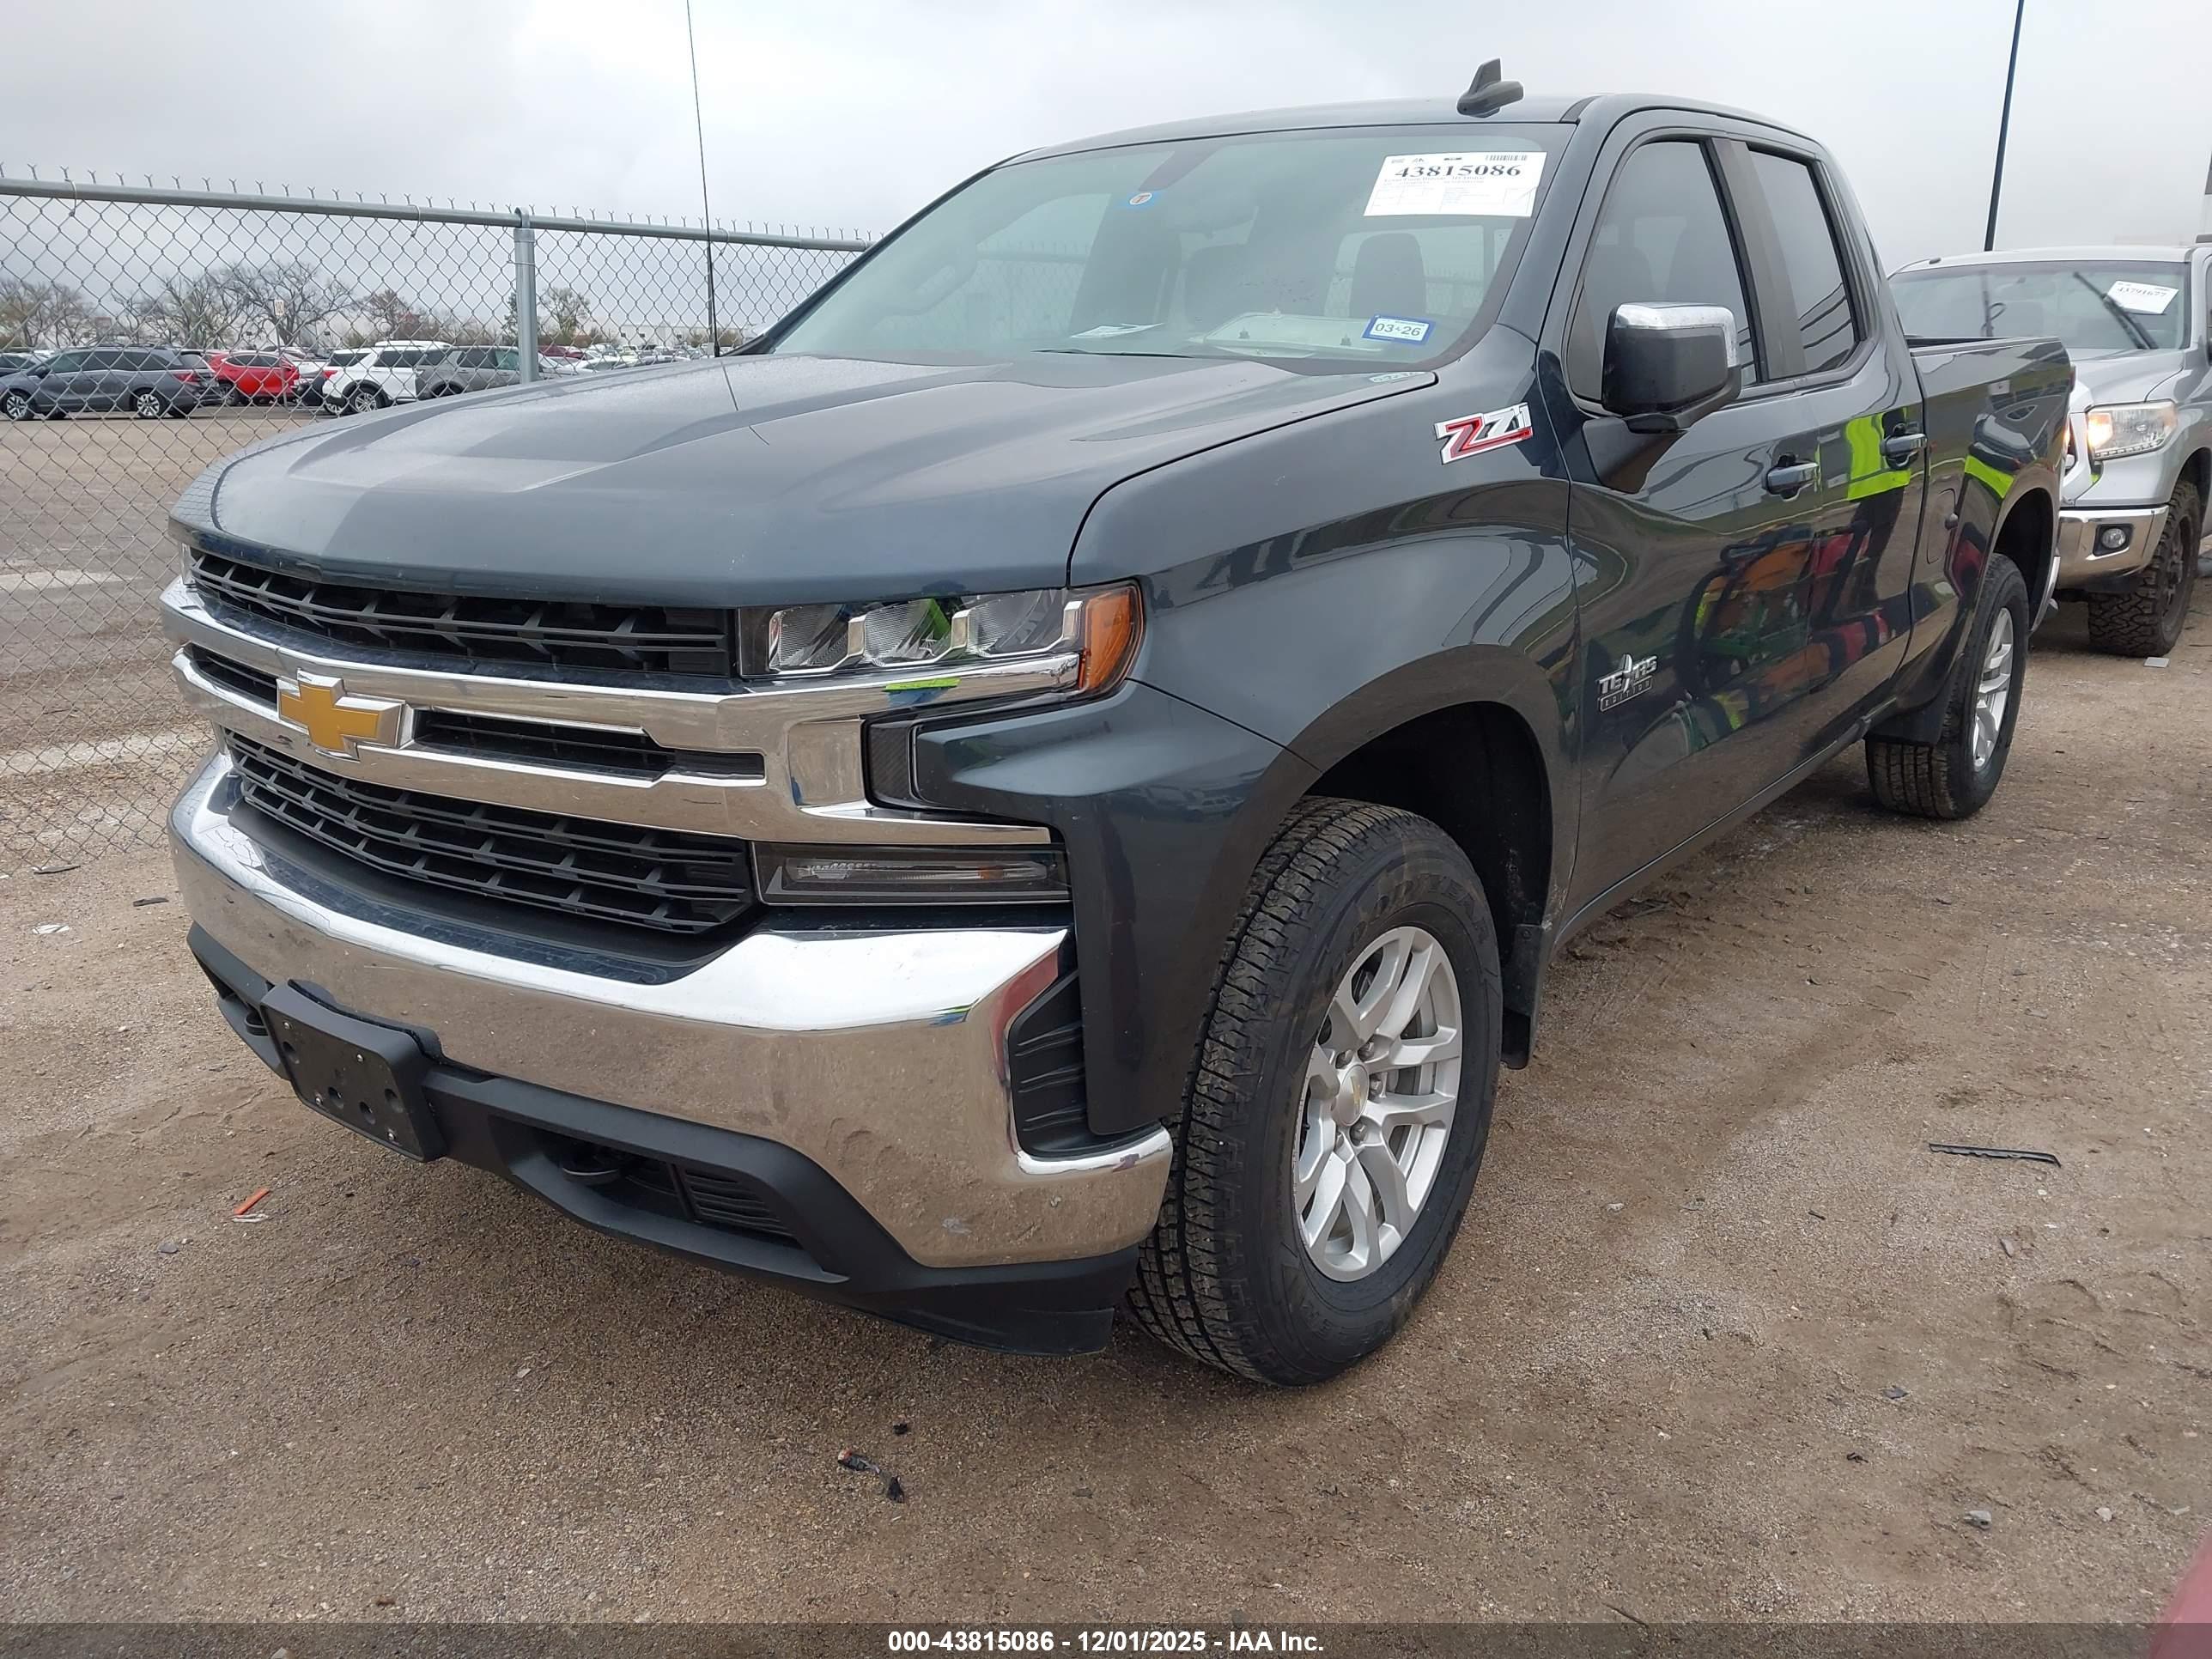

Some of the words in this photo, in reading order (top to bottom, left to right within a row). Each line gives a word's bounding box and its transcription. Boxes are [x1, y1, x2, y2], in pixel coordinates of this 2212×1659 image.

[1395, 165, 1522, 178] 43815086
[1375, 323, 1395, 333] 03
[1401, 325, 1421, 337] 26
[1433, 403, 1534, 465] Z71
[1598, 654, 1657, 694] TEXAS
